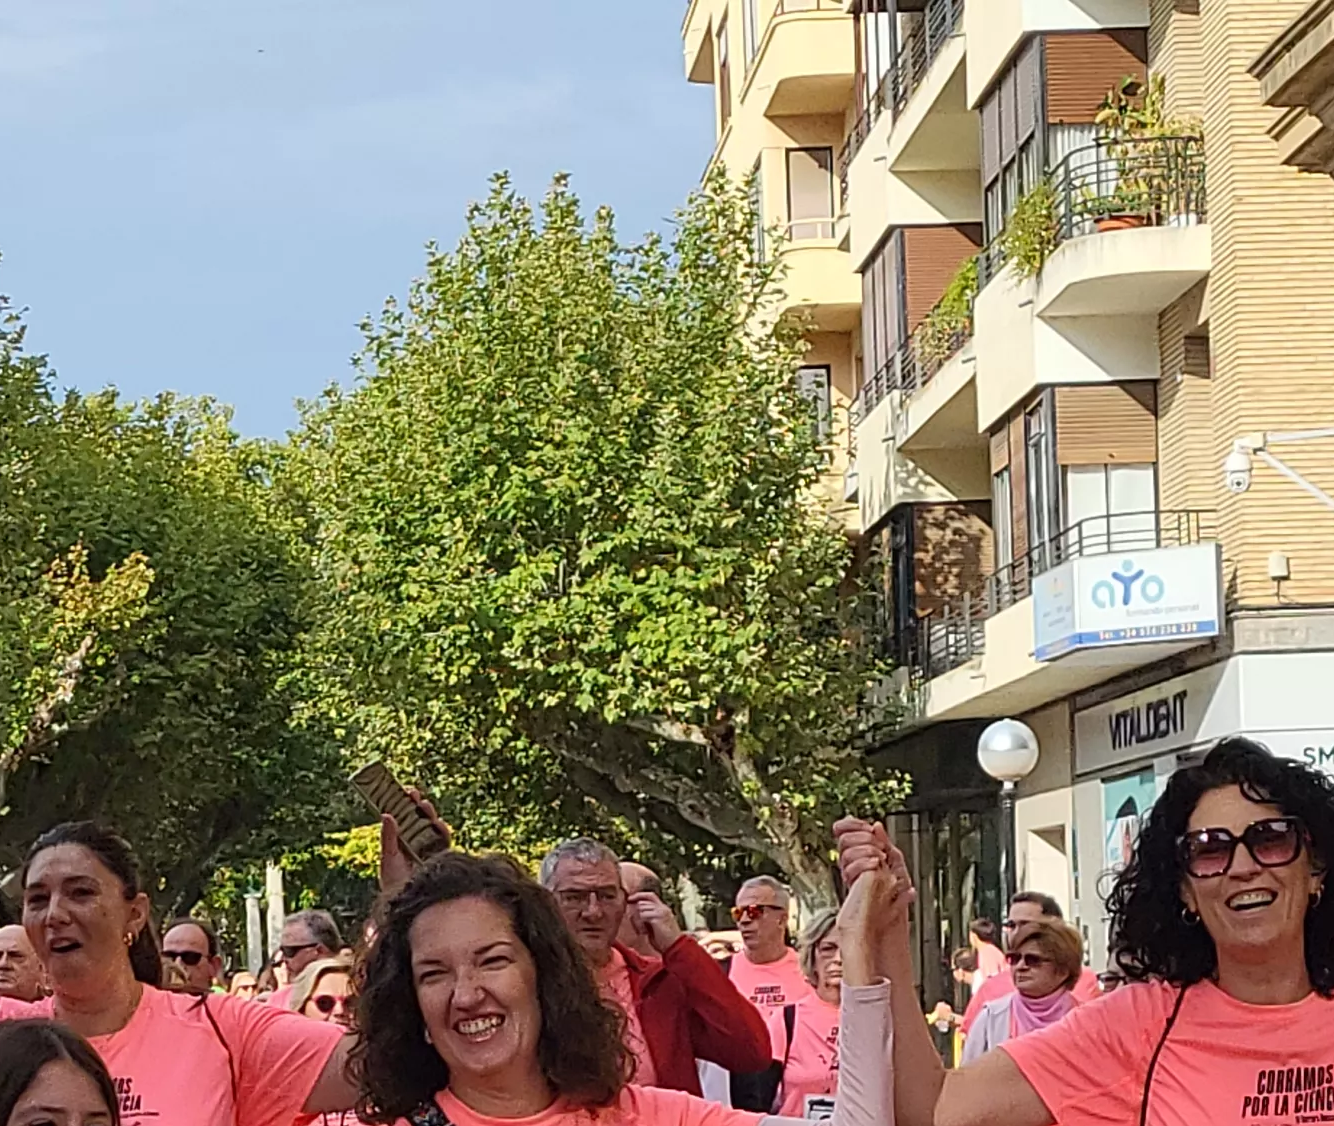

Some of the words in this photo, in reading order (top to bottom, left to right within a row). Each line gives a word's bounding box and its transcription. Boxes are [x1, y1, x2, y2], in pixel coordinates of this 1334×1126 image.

[1109, 689, 1188, 751] VITALDENT
[1256, 1063, 1334, 1096] CORRAMOS
[1241, 1095, 1270, 1119] POR
[1274, 1094, 1289, 1116] LA
